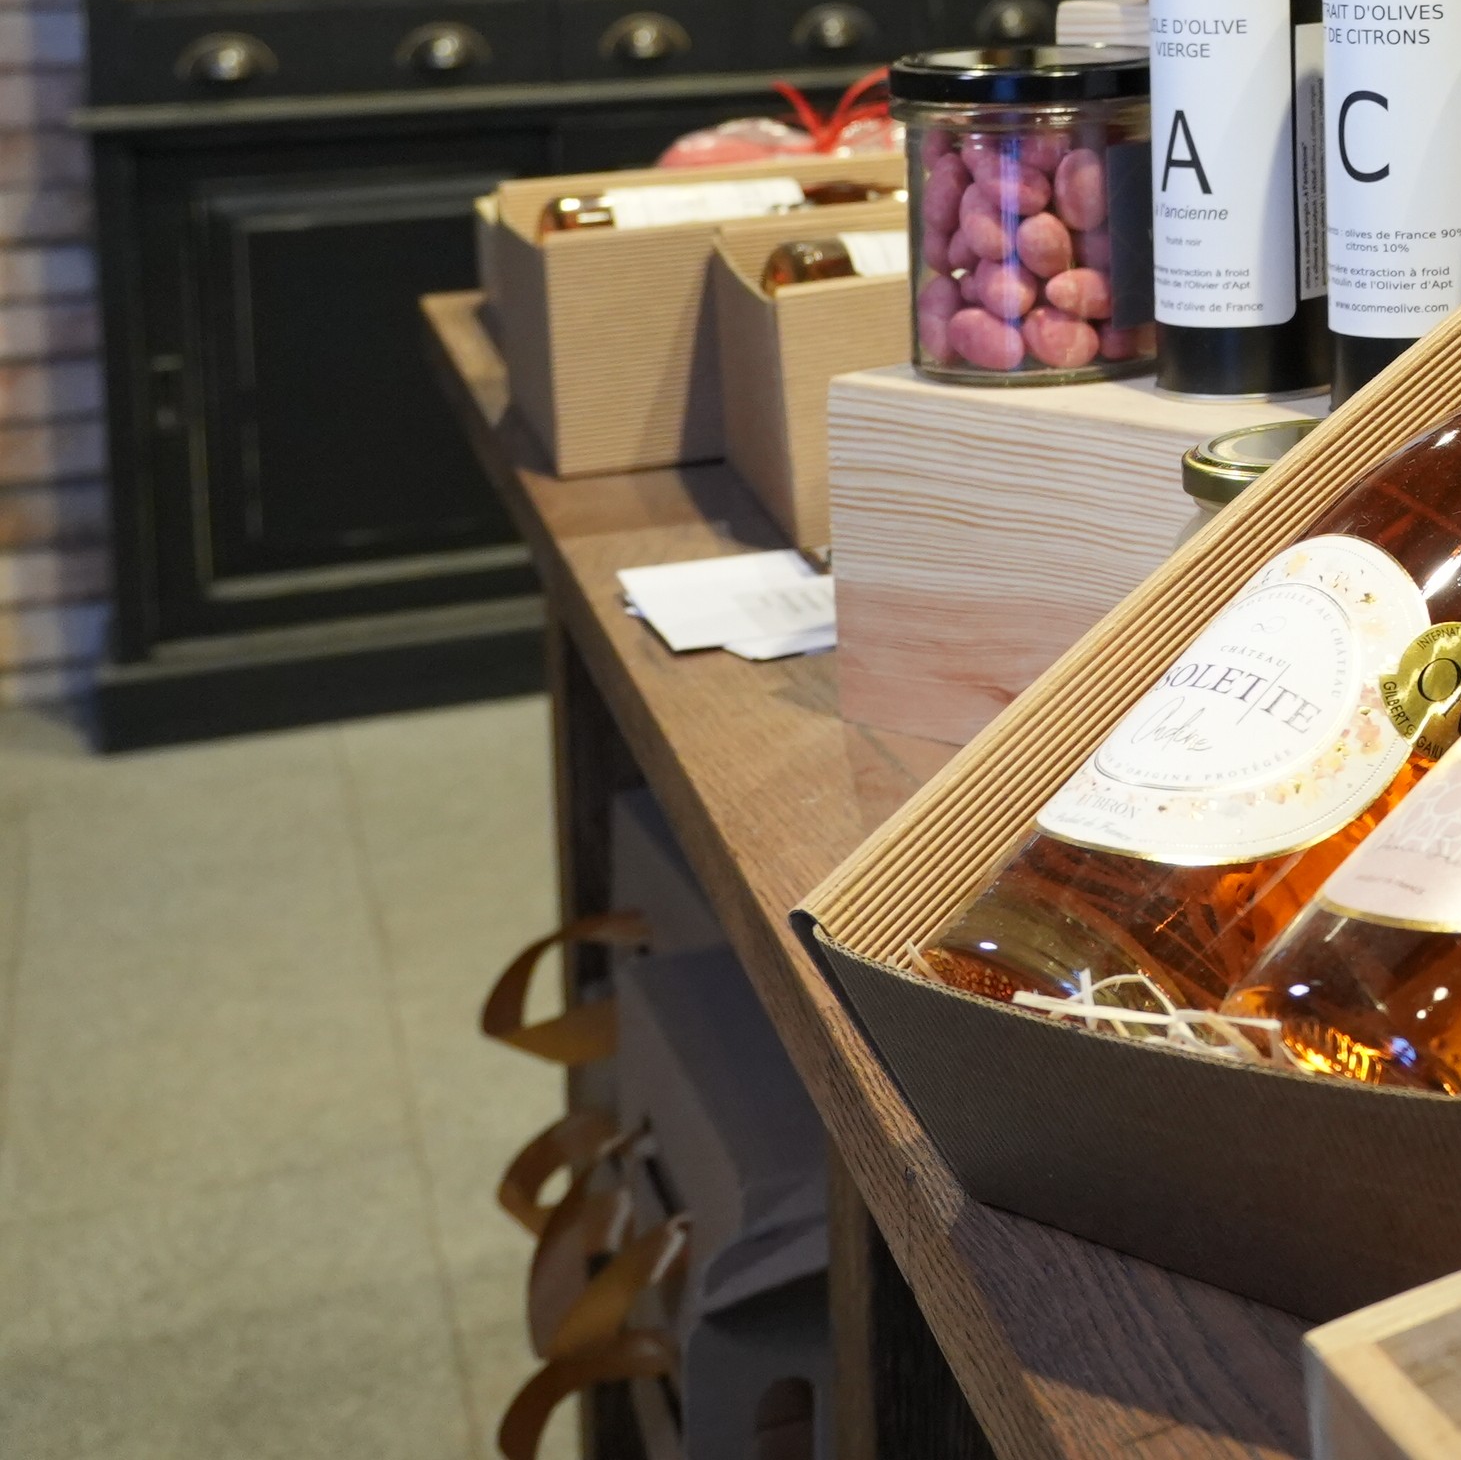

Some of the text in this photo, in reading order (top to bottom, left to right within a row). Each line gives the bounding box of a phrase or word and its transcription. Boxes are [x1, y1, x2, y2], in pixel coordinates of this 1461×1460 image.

[1354, 3, 1444, 21] D'OLIVES
[1173, 18, 1248, 35] D'OLIVE
[1328, 26, 1430, 45] DE CITRONS
[1156, 42, 1211, 58] VIERGE
[1338, 90, 1390, 183] C
[1160, 109, 1212, 195] A
[1159, 203, 1229, 221] l'ancienne
[1345, 228, 1372, 239] olives
[1375, 230, 1391, 240] de
[1395, 230, 1437, 240] France
[1345, 243, 1410, 253] citrons 10%
[1225, 268, 1250, 278] froid
[1350, 266, 1450, 278] extraction à froid
[1354, 279, 1367, 289] de
[1370, 280, 1416, 290] l'Olivier
[1420, 280, 1454, 290] d'Apt
[1209, 301, 1222, 313] de
[1226, 300, 1264, 312] France
[1157, 662, 1322, 735] SOLETTE
[1383, 681, 1410, 726] GILBERT
